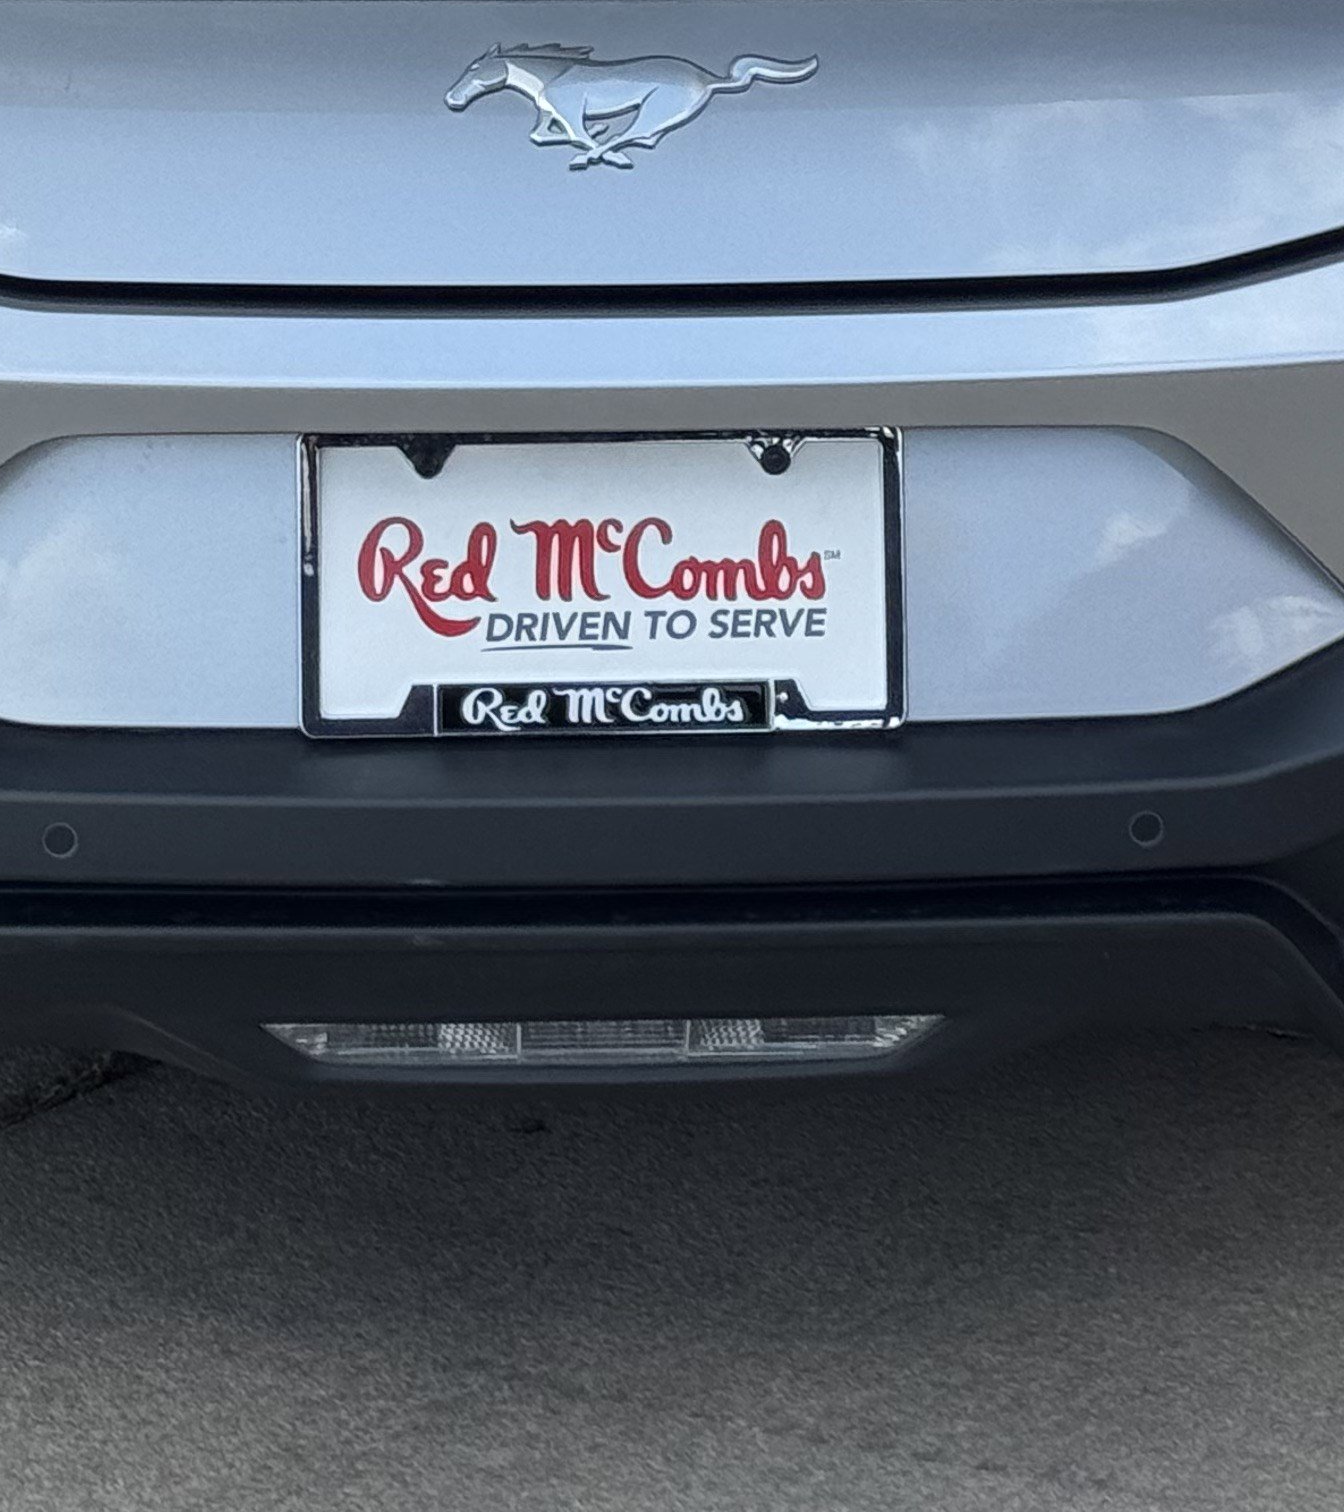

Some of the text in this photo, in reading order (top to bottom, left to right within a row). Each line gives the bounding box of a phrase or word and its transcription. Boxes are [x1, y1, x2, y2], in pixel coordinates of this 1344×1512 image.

[358, 517, 497, 637] Red
[509, 517, 826, 602] McCombs
[485, 608, 828, 642] DRIVEN TO SERVE
[463, 687, 743, 728] Red McCombs
